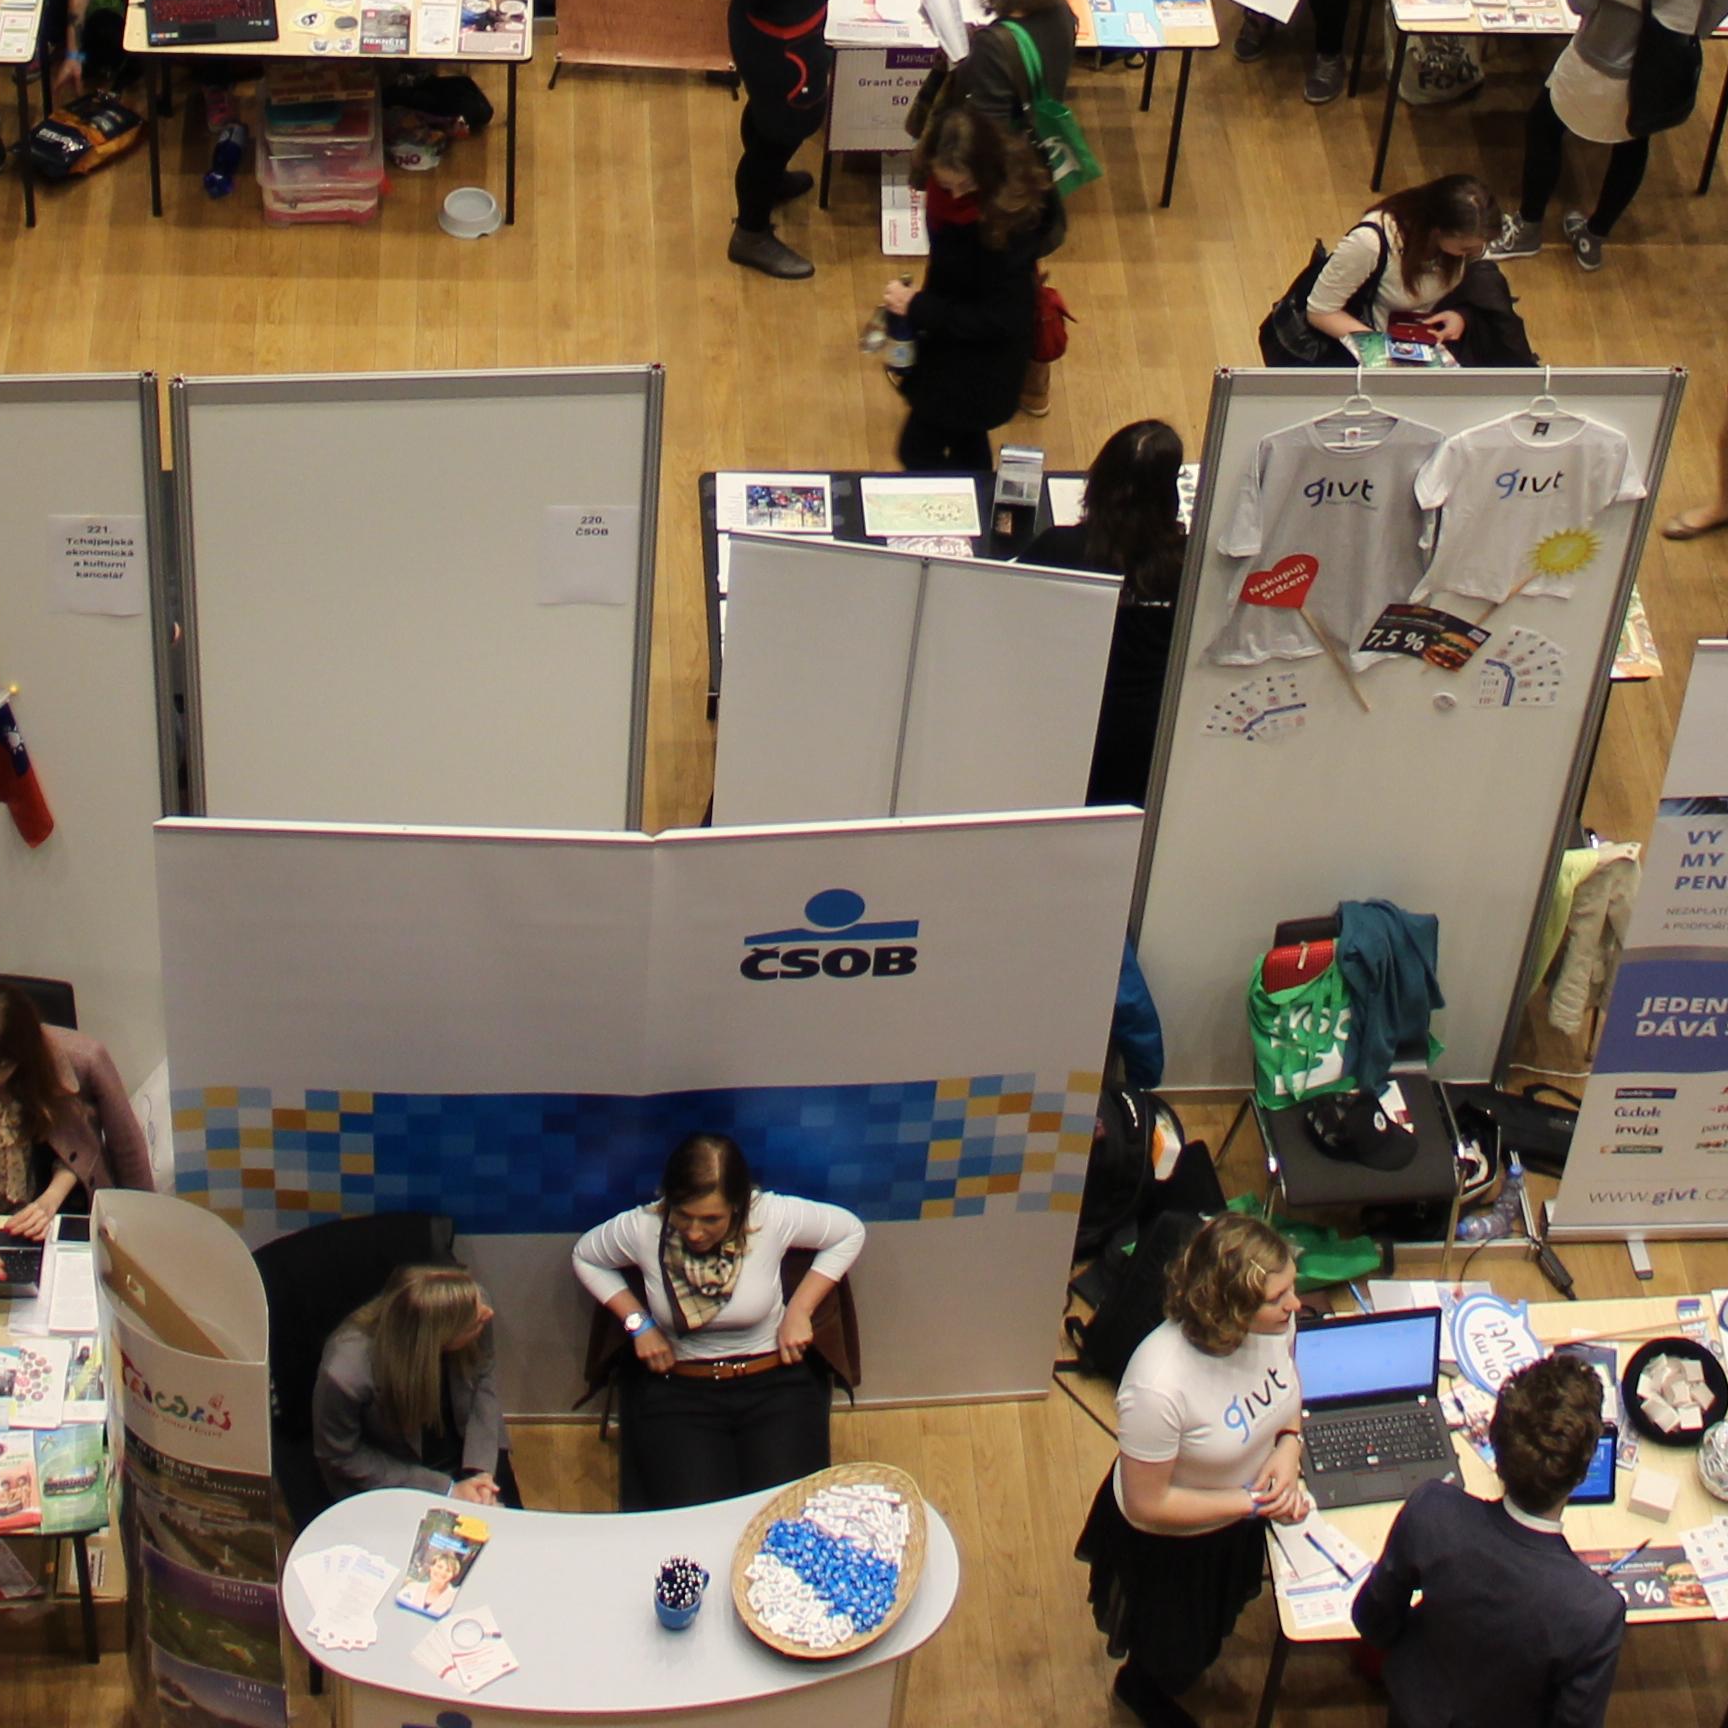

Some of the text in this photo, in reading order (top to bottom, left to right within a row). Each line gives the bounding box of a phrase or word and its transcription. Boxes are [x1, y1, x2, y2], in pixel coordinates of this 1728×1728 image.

[892, 95, 909, 107] 50
[1304, 475, 1376, 509] givt
[1495, 468, 1565, 499] givt
[575, 524, 610, 536] ČSOB
[579, 515, 606, 525] 220.
[1248, 562, 1308, 597] Nakupuji
[1366, 626, 1425, 653] 7,5 %
[1686, 830, 1724, 846] VY
[1680, 850, 1722, 869] MY
[740, 944, 918, 980] ČSOB
[1637, 994, 1728, 1016] JEDEN
[1635, 1012, 1716, 1038] DÁVÁ
[1615, 1123, 1659, 1136] invia
[1224, 1367, 1288, 1444] givt
[1635, 1578, 1666, 1603] %
